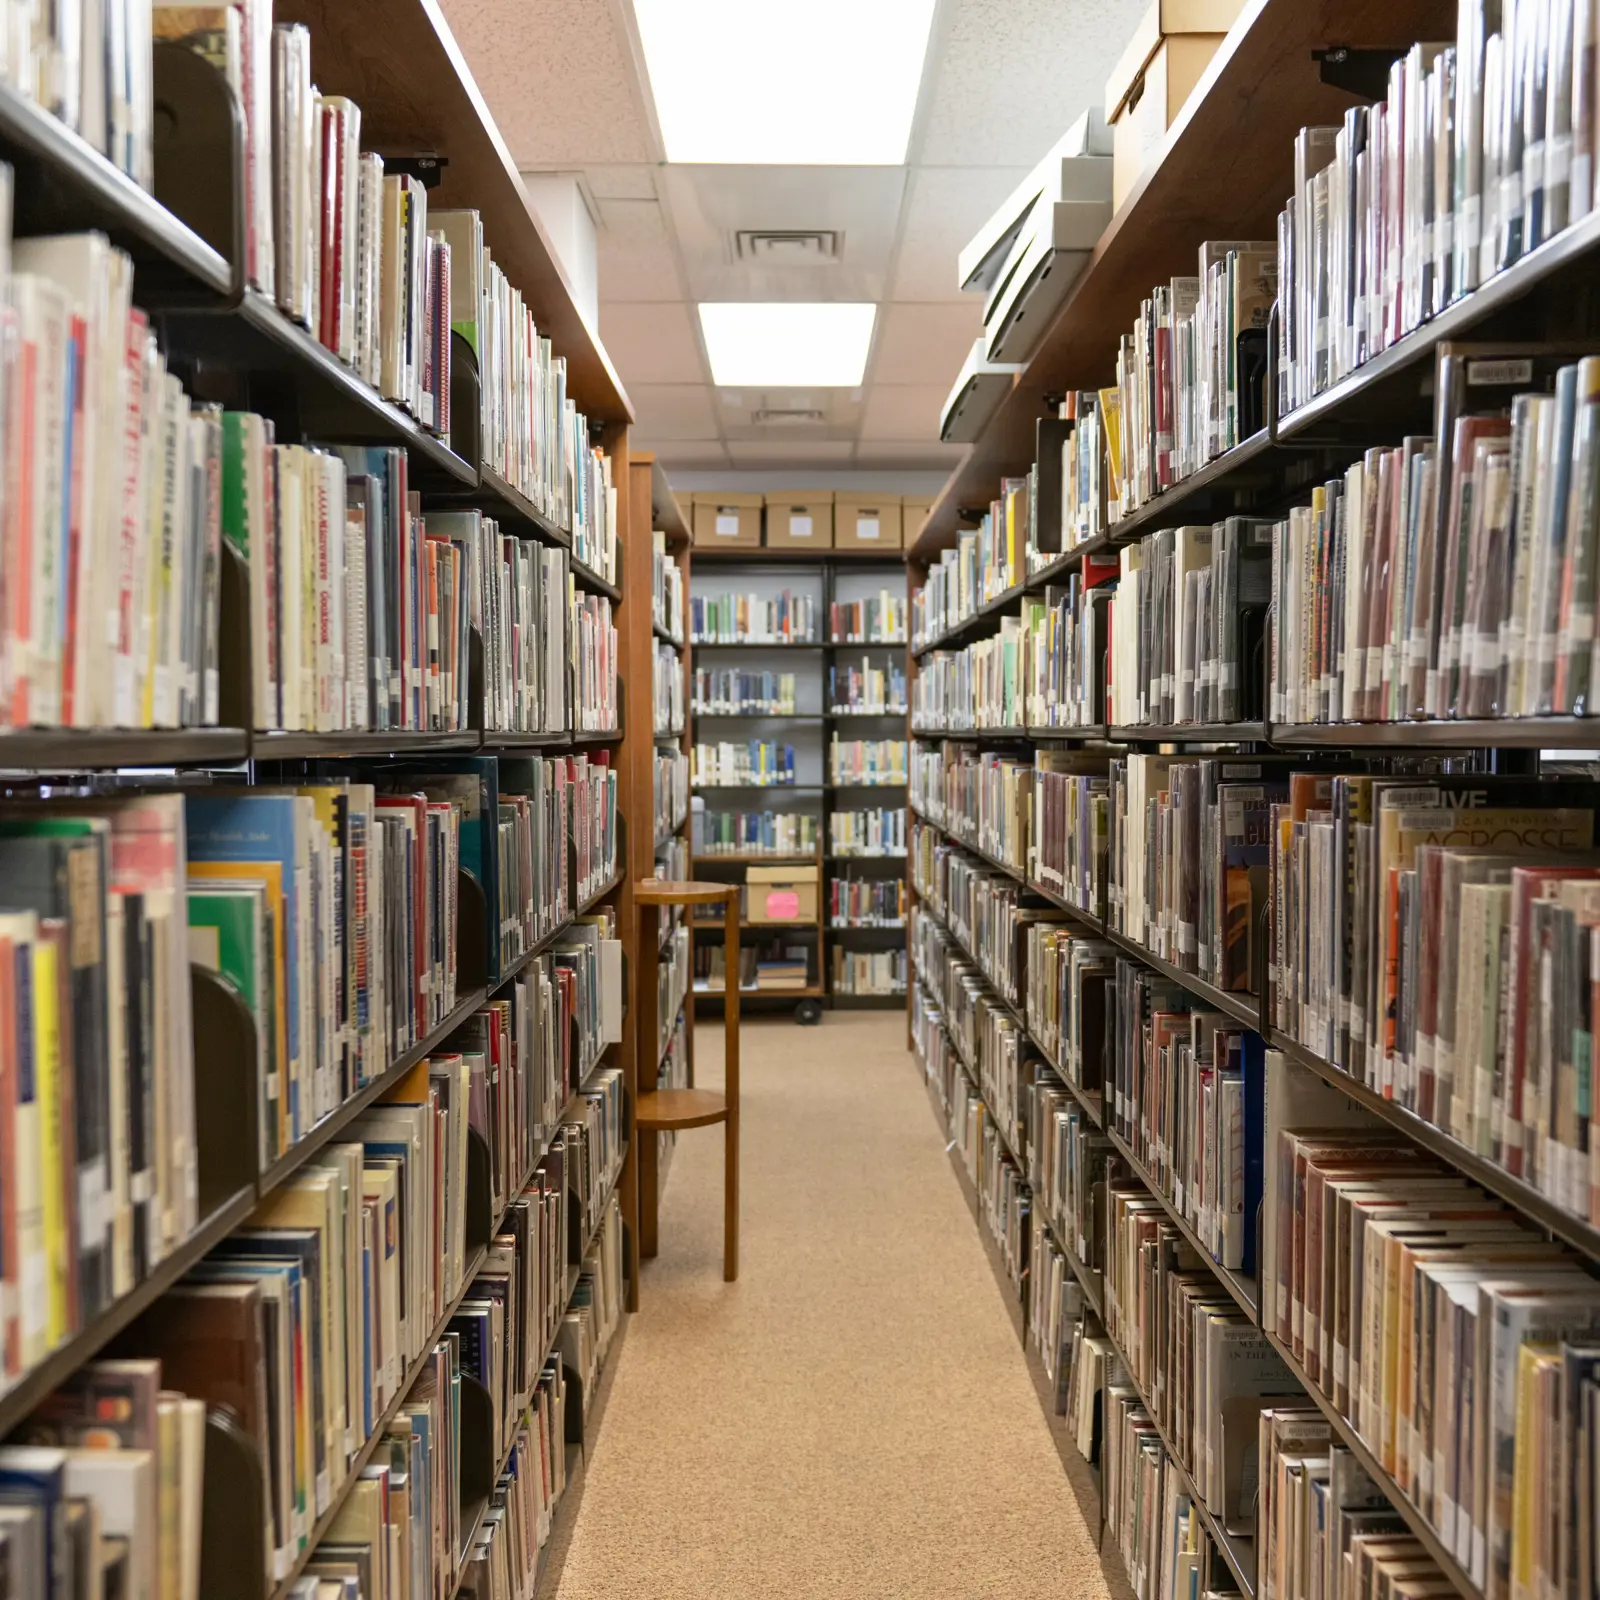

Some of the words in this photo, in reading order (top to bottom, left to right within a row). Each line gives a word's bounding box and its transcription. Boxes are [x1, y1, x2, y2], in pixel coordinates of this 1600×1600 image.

[320, 590, 329, 645] Cookbook
[1276, 878, 1284, 953] AMERICAN
[1246, 1351, 1265, 1359] THE
